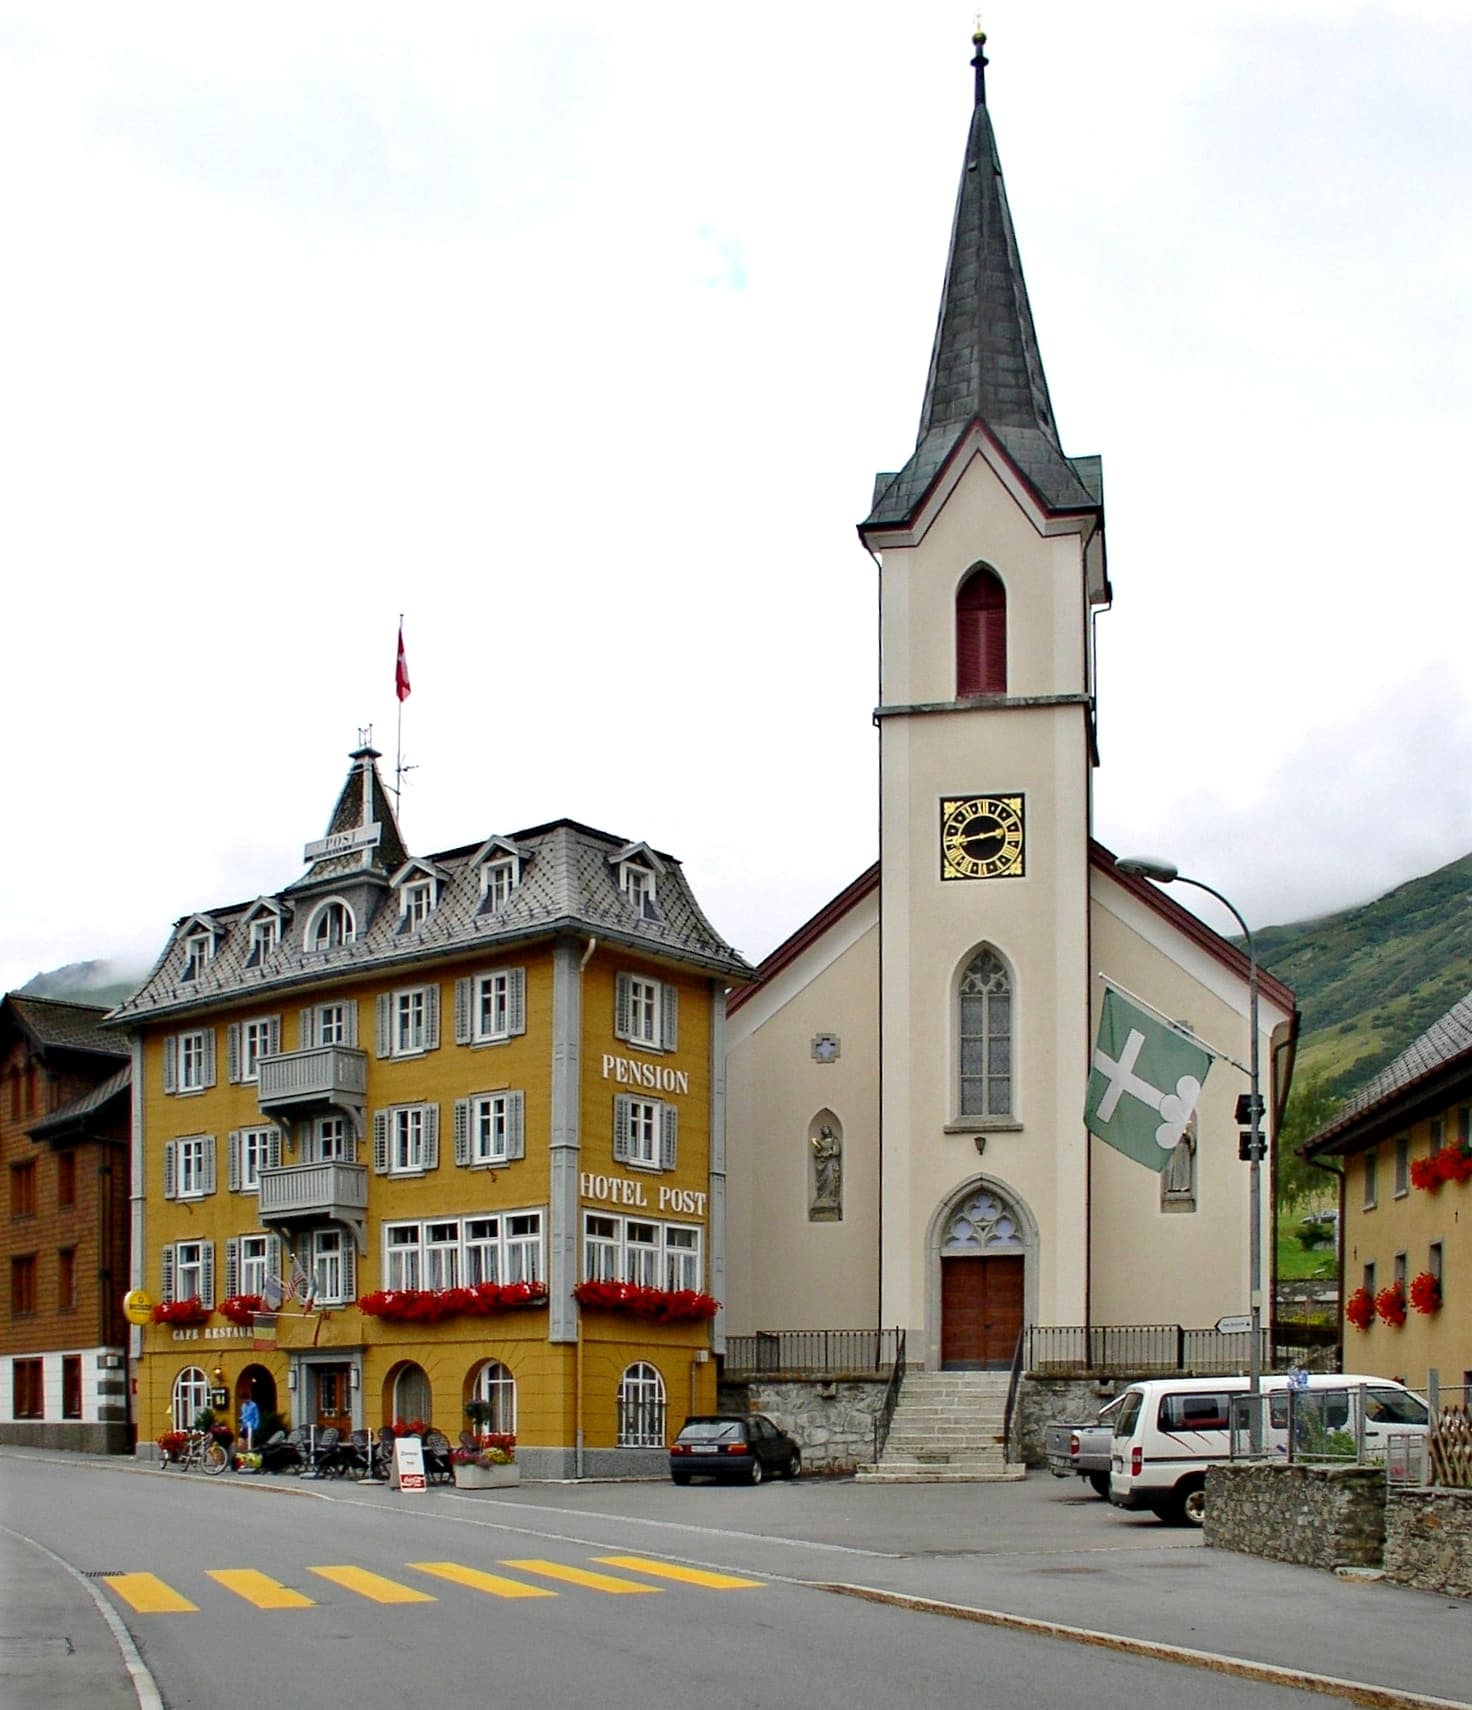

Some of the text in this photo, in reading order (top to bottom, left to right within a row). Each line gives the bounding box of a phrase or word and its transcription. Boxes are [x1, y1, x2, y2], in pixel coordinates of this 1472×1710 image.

[326, 832, 356, 850] POST
[602, 1054, 689, 1095] PENSION
[580, 1172, 707, 1216] HOTEL POST
[204, 1326, 253, 1339] RESTAUR
